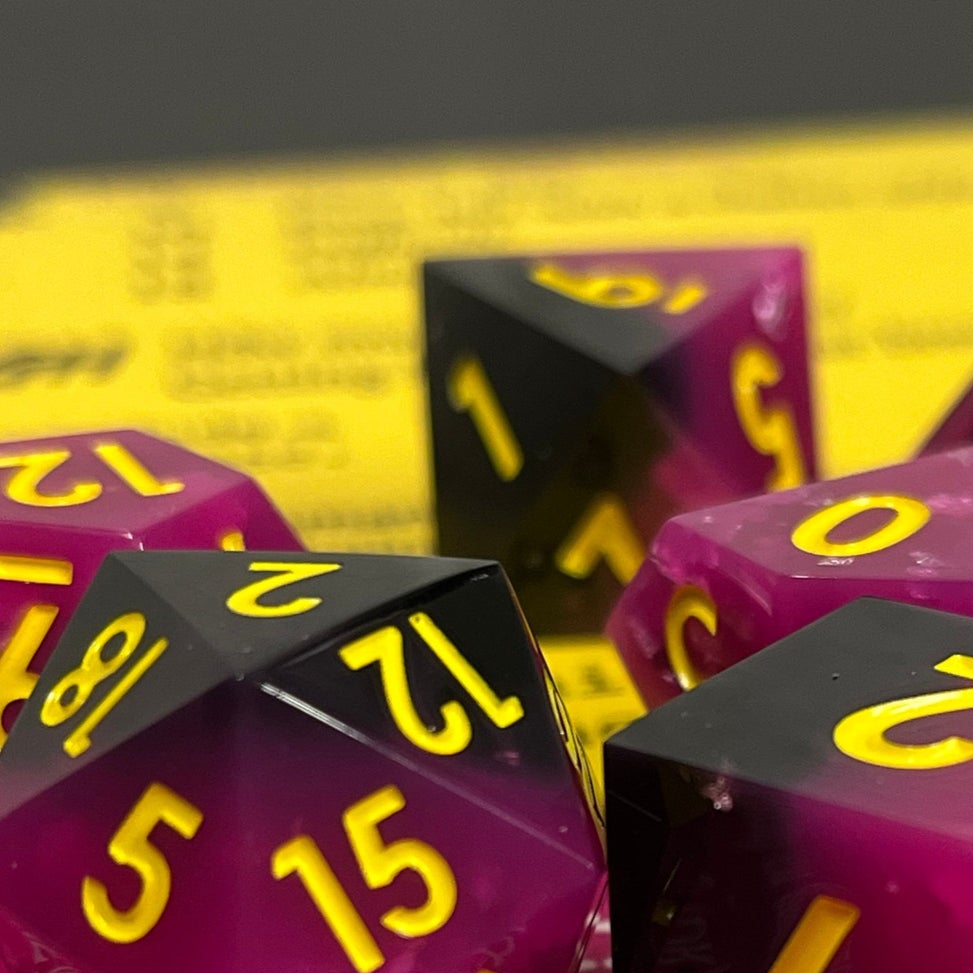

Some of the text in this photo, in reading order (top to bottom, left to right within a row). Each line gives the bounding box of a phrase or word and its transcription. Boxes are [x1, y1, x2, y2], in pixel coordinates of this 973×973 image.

[0, 444, 185, 507] 12
[452, 354, 523, 481] 1
[226, 561, 344, 618] 2
[791, 495, 932, 557] 0
[40, 612, 169, 759] 18
[338, 612, 525, 756] 12
[81, 782, 204, 944] 5
